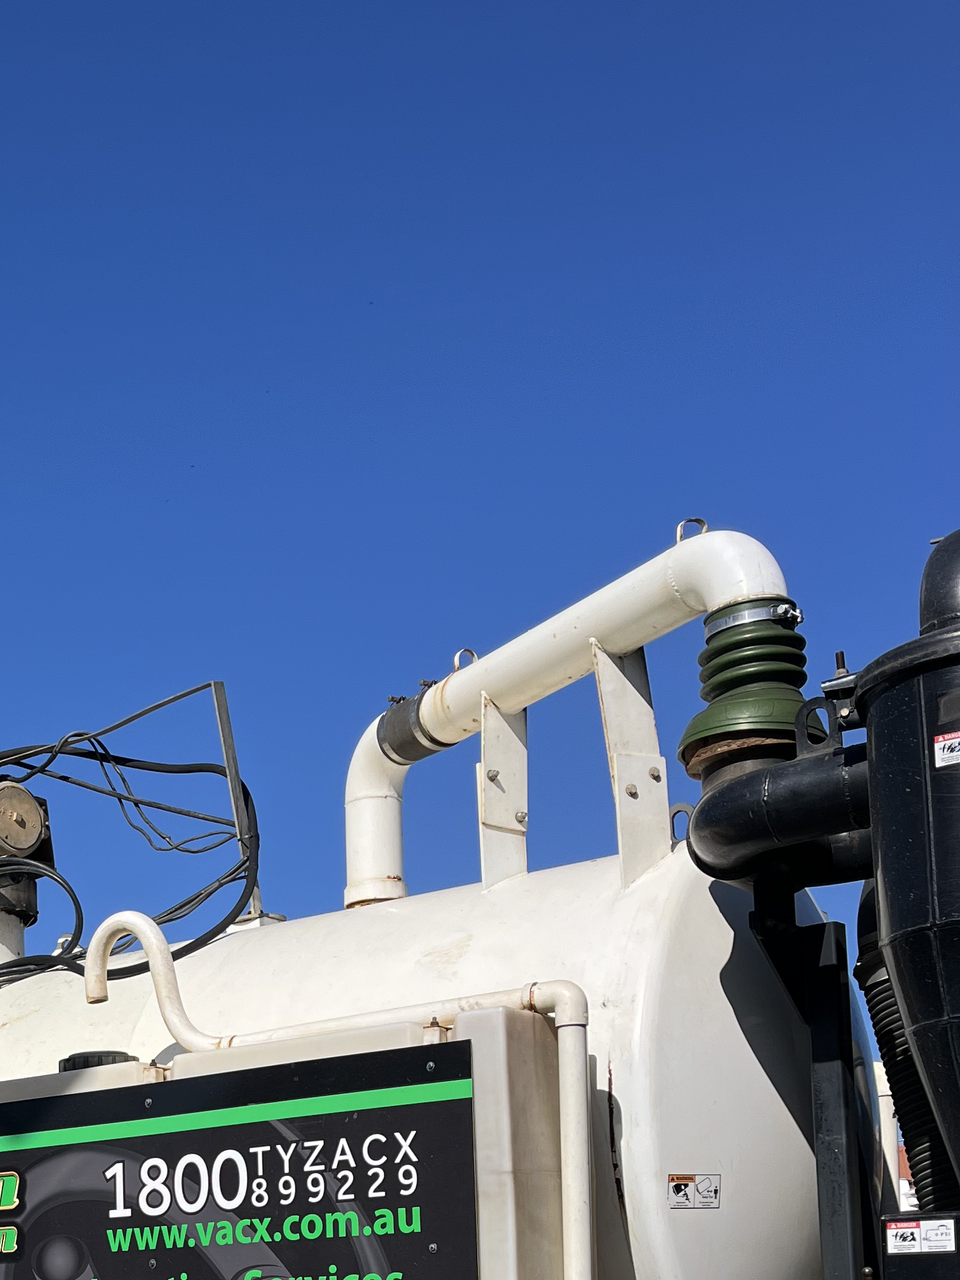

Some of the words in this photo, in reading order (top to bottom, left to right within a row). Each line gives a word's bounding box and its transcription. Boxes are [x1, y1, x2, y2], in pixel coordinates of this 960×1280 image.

[249, 1131, 418, 1176] TYZACX
[104, 1149, 248, 1219] 1800
[251, 1165, 419, 1208] 899229
[106, 1206, 422, 1252] www.vacx.com.au
